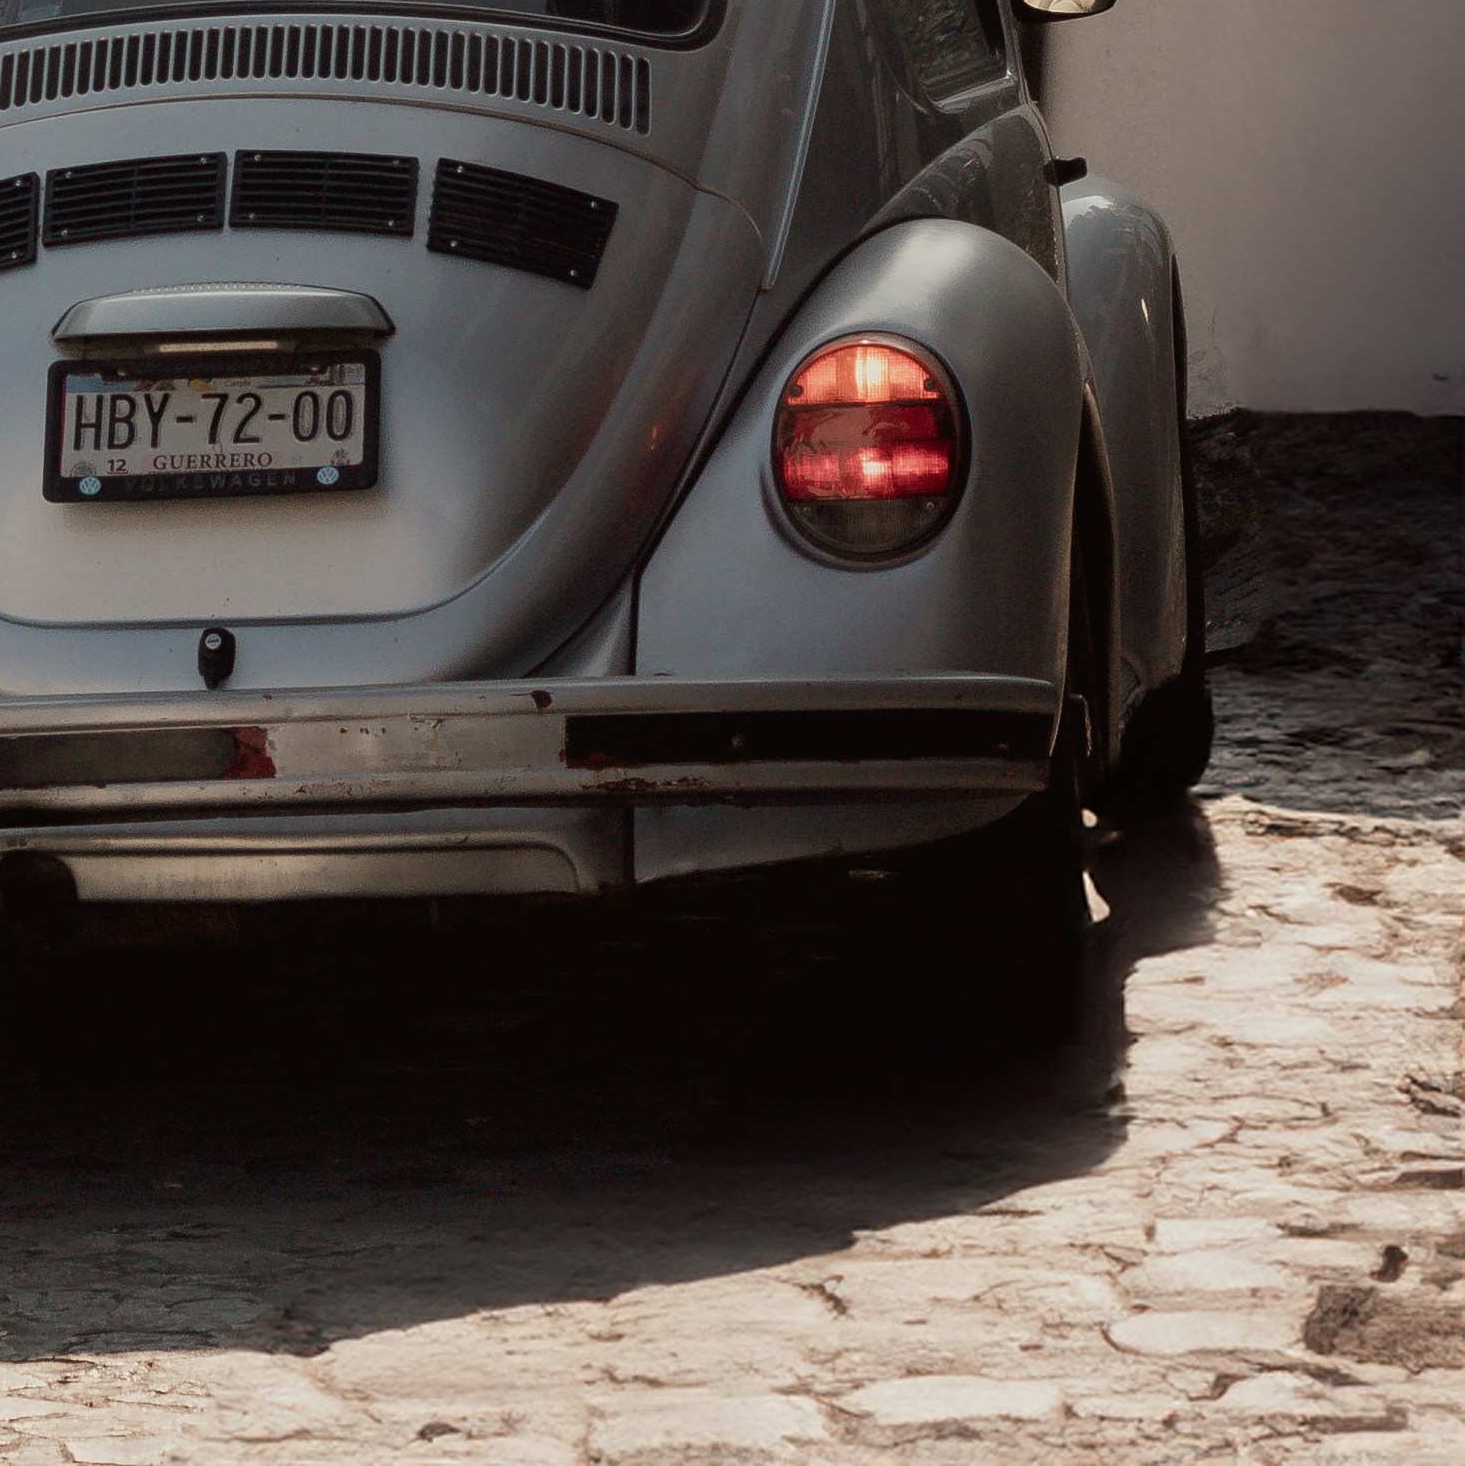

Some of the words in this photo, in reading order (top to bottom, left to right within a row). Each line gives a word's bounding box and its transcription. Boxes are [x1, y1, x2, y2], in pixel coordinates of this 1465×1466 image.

[73, 389, 354, 451] HBY-72-00
[107, 458, 128, 473] 12
[153, 452, 273, 470] GUERRERO
[125, 470, 297, 494] VOLKSWAGEN
